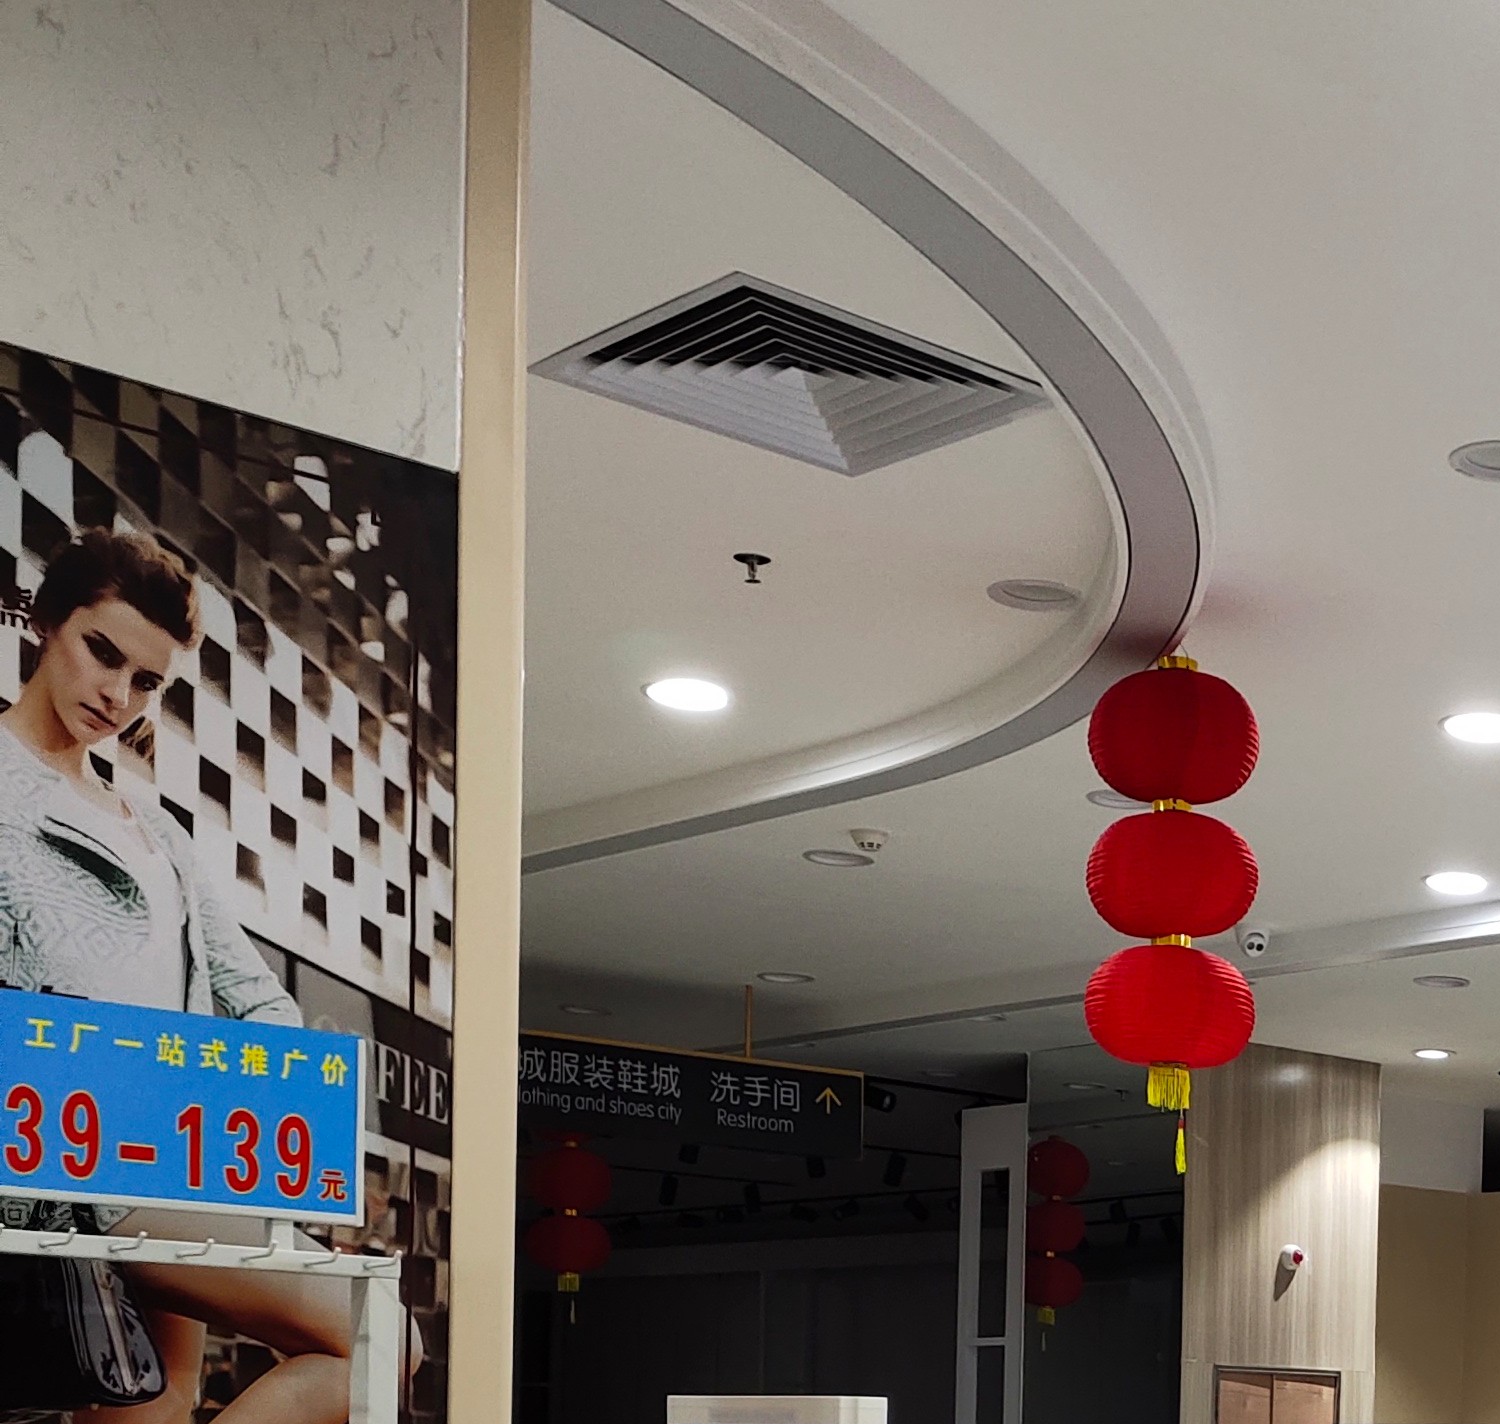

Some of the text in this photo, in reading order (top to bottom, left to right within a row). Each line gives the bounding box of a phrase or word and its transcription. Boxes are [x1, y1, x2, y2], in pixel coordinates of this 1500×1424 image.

[23, 1017, 350, 1087] 工厂一站式推广价
[575, 1093, 605, 1114] and
[609, 1096, 655, 1118] shoes
[658, 1102, 682, 1126] city
[709, 1070, 801, 1113] 洗手间
[716, 1108, 795, 1133] Restroom
